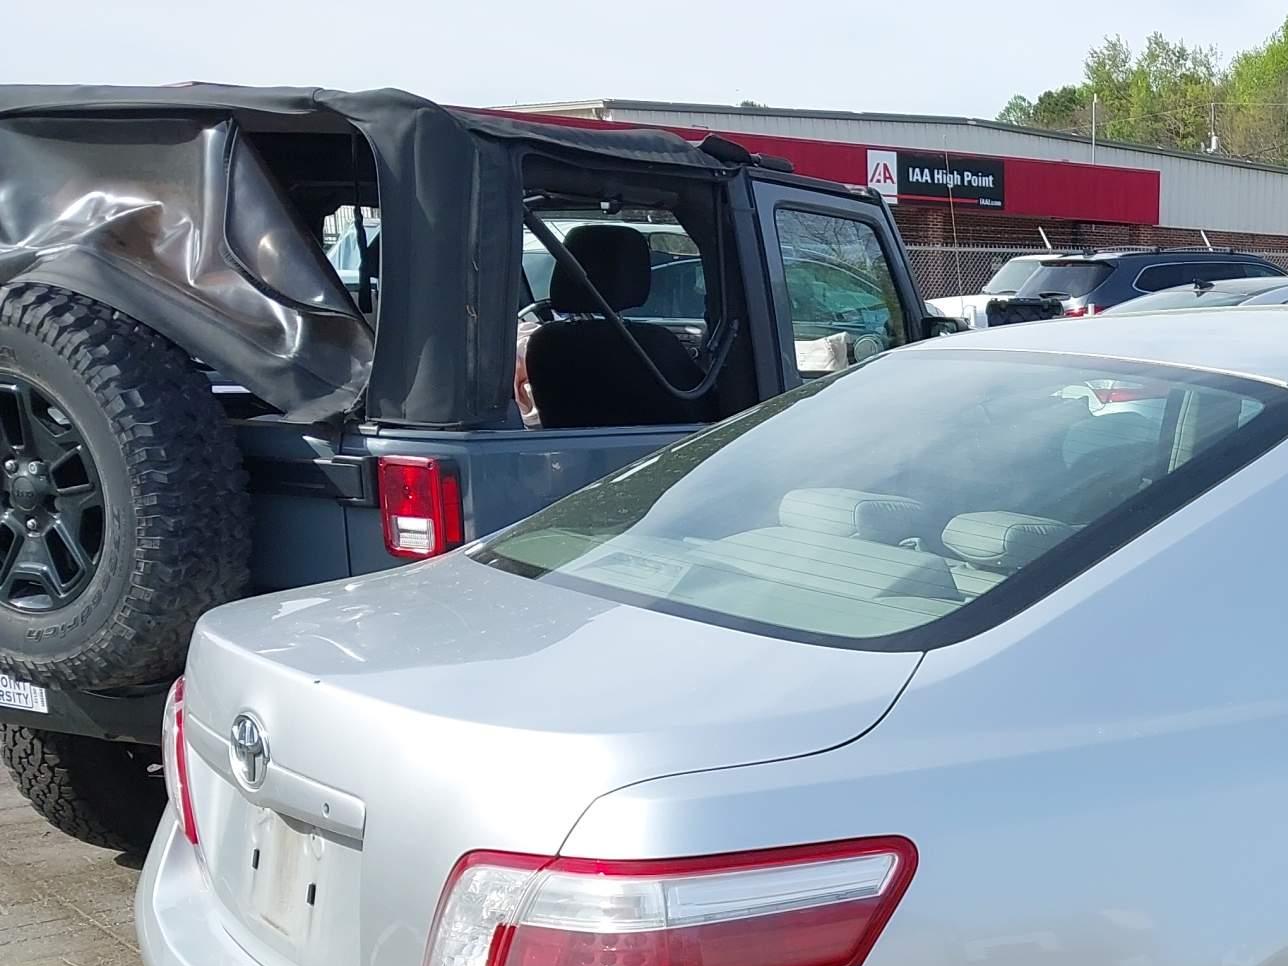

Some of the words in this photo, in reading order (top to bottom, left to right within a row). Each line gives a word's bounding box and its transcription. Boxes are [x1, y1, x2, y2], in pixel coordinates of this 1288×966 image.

[908, 167, 932, 184] IAA
[934, 169, 961, 188] High
[963, 171, 994, 188] Point
